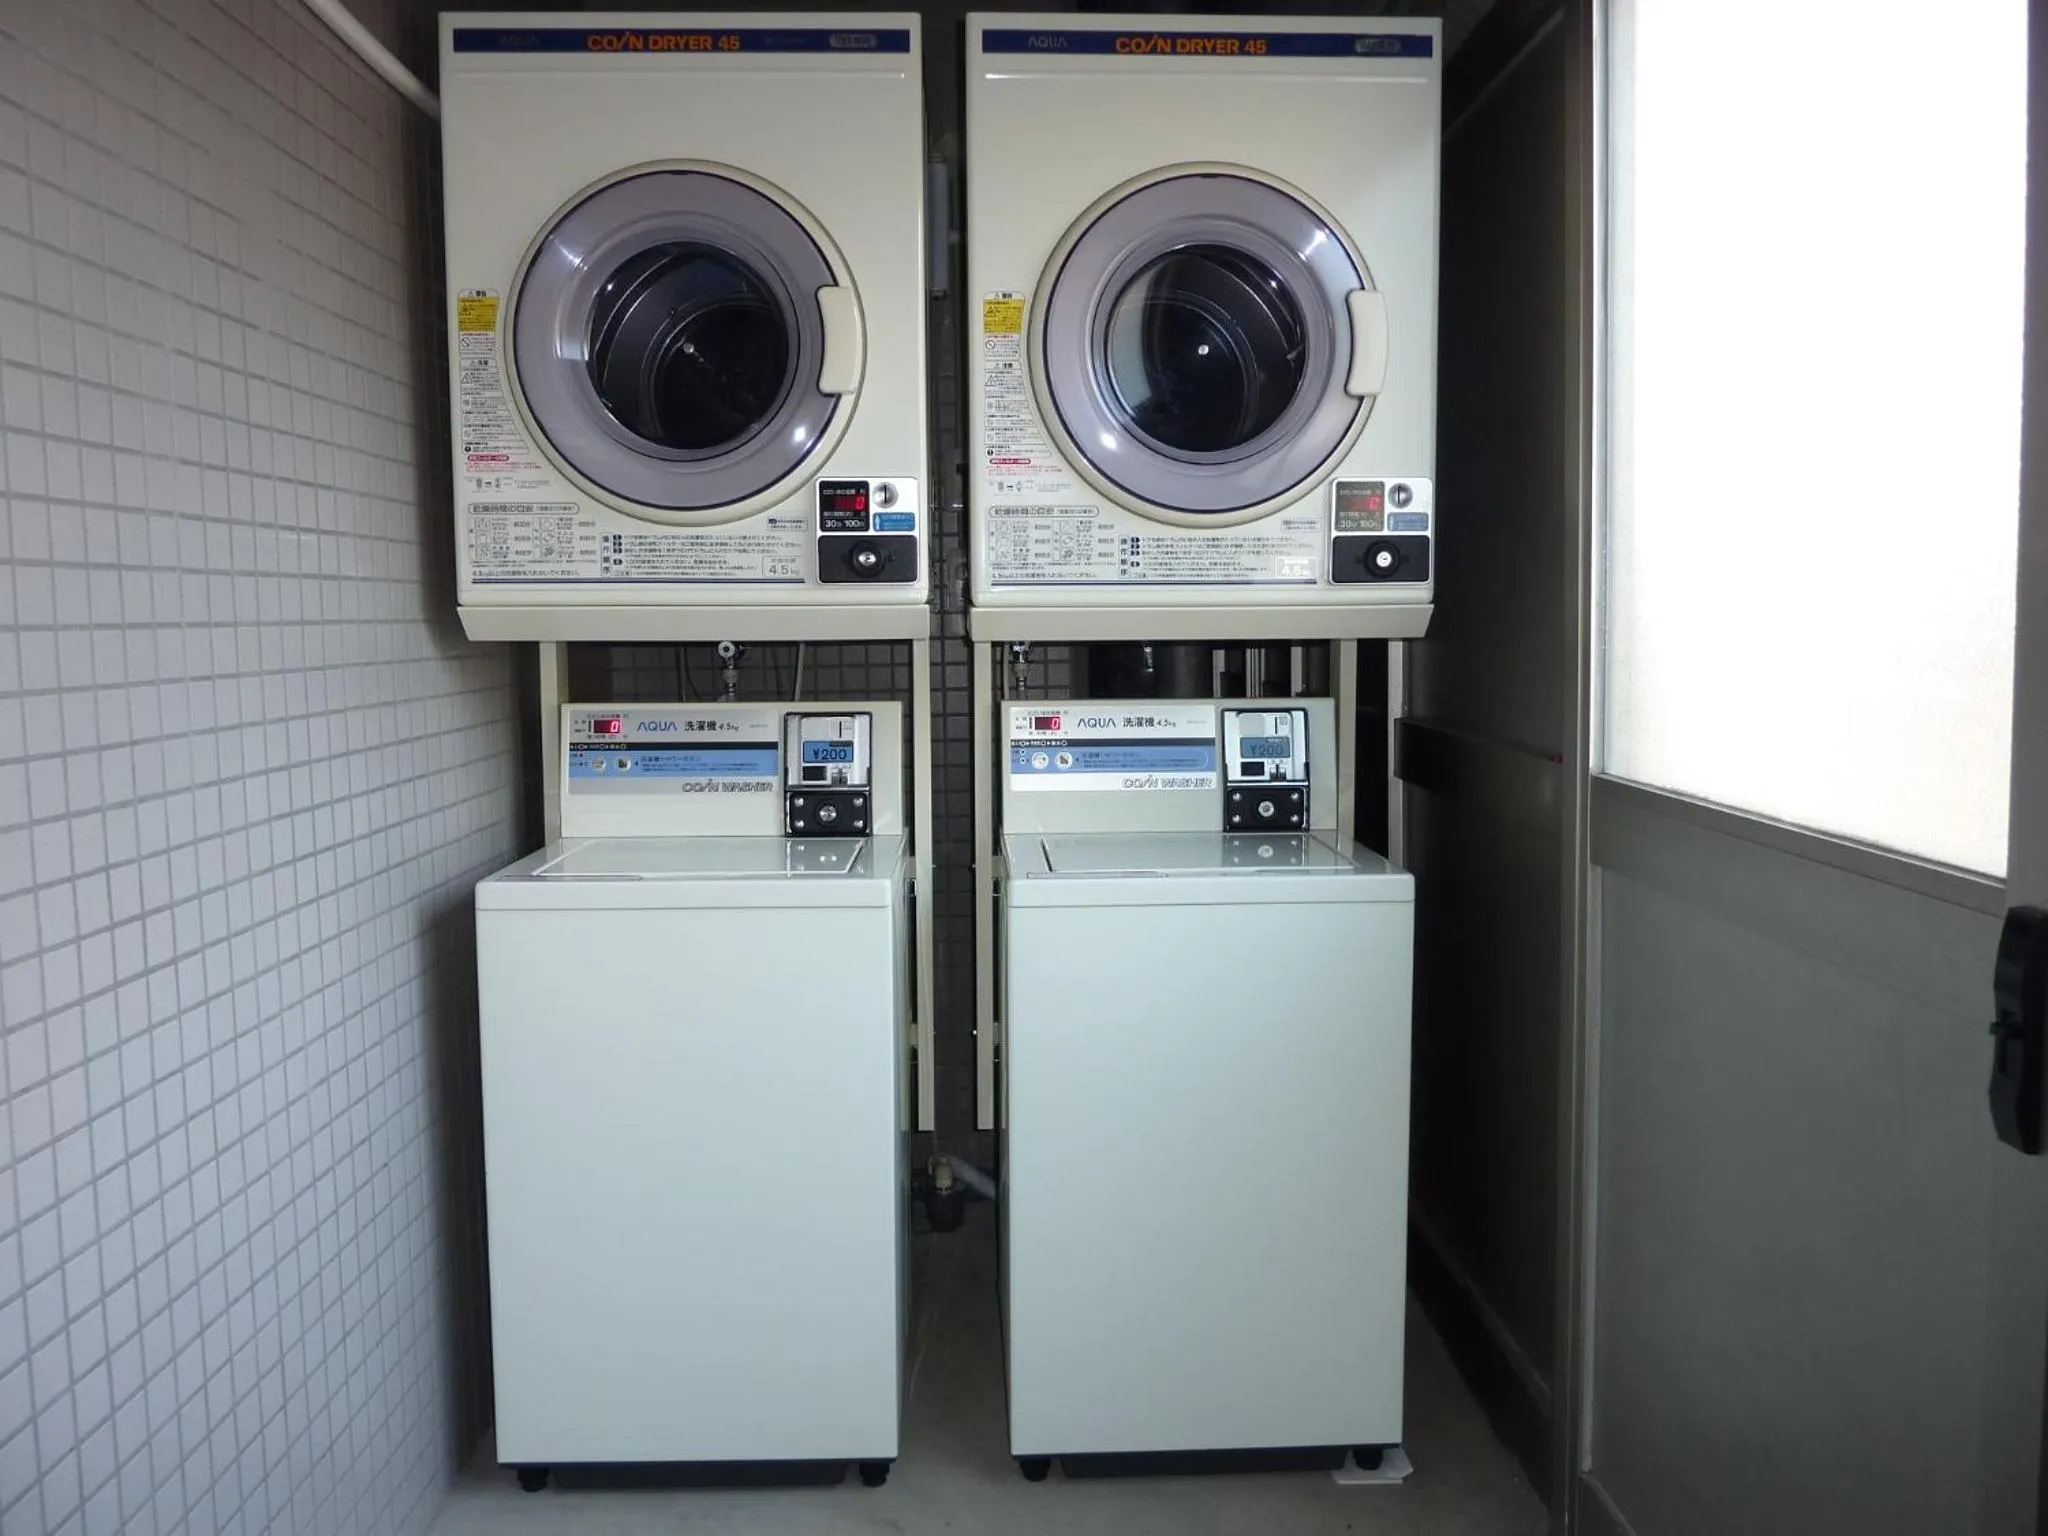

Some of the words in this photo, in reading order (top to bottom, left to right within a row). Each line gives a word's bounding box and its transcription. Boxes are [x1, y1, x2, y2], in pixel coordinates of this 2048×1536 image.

[648, 35, 713, 51] DRYER
[718, 35, 741, 51] 45
[1028, 35, 1068, 47] AQUA
[1176, 39, 1240, 55] DRYER
[1244, 39, 1267, 55] 45
[611, 721, 619, 732] 0
[637, 721, 677, 732] AQUA
[684, 720, 717, 731] 洗濯機
[1051, 718, 1059, 729] 0
[1077, 717, 1116, 728] AQUA
[1123, 716, 1155, 727] 洗濯機
[813, 748, 847, 760] ¥200
[721, 782, 773, 793] WASHER
[1161, 777, 1212, 788] WASHER
